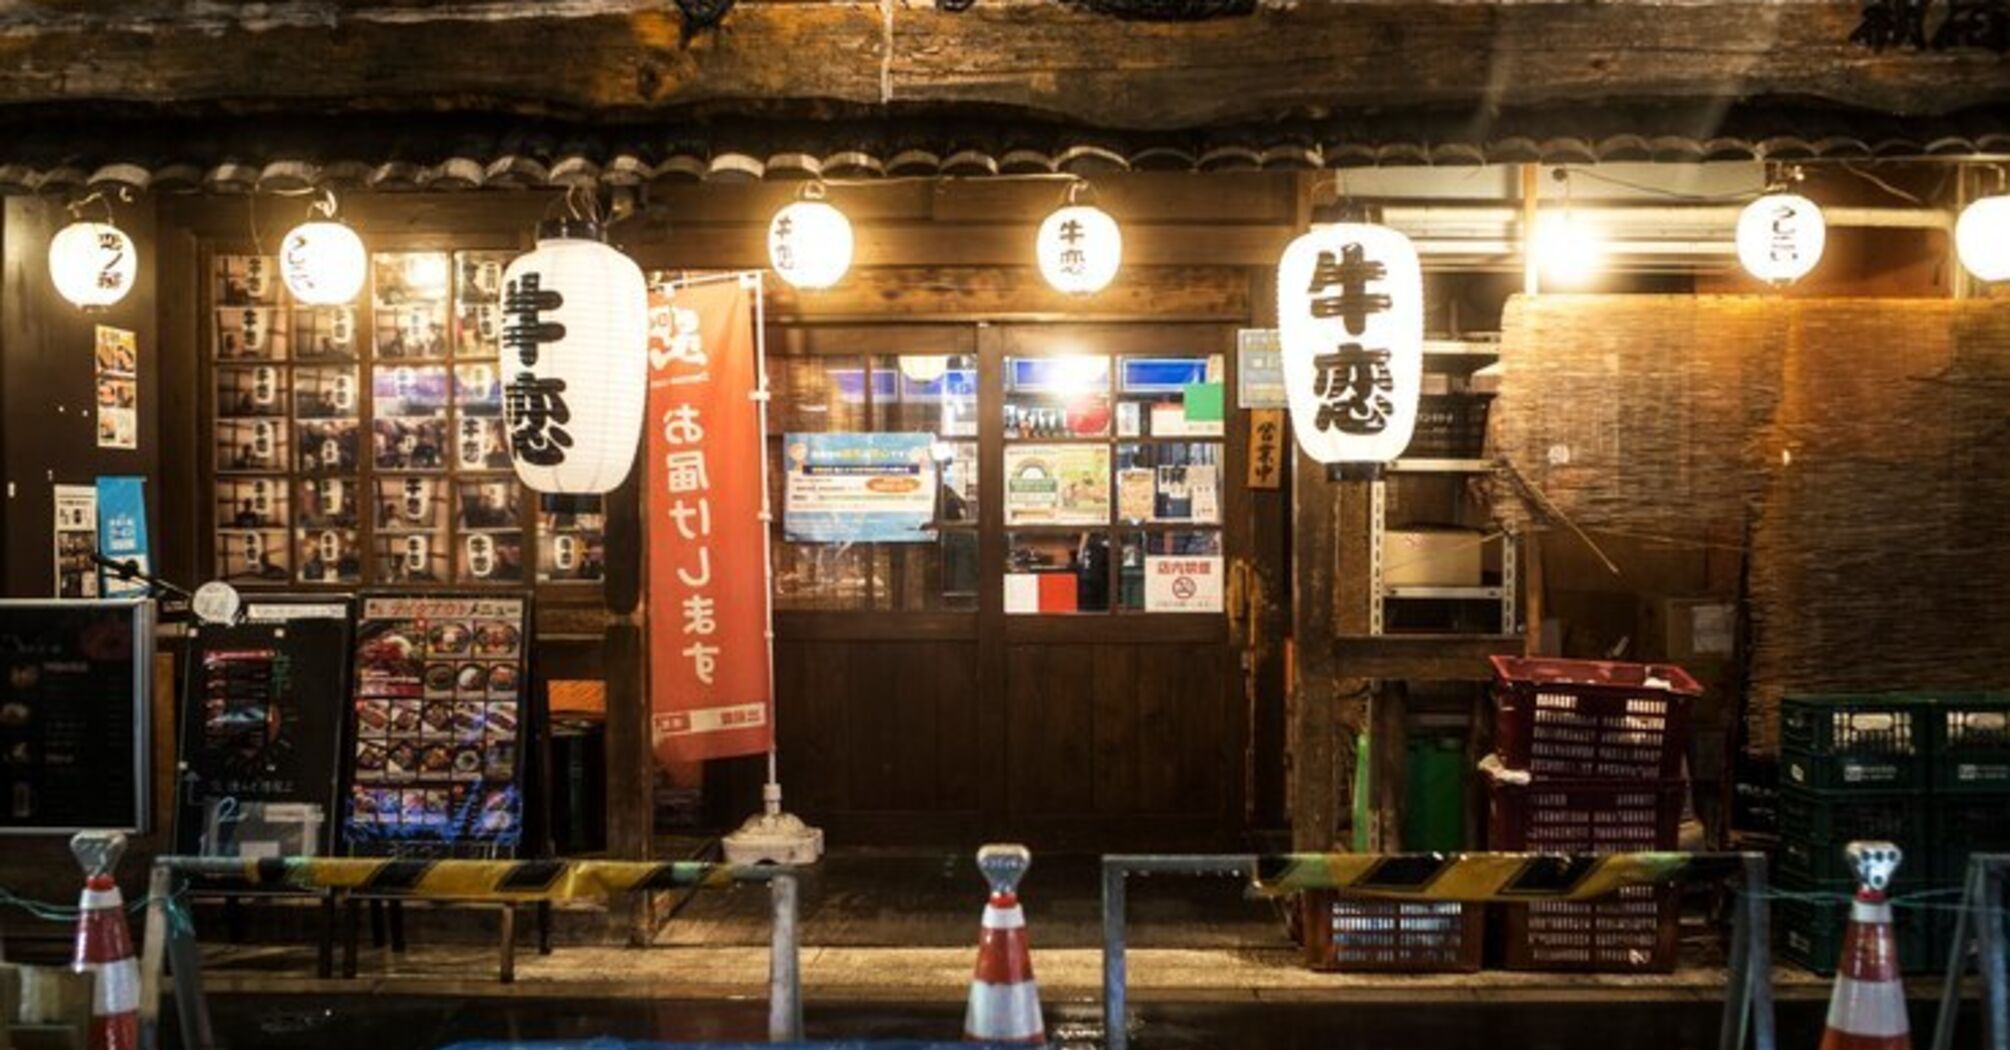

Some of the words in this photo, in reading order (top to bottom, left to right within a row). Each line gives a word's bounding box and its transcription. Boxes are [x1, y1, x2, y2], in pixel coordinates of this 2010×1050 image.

[774, 214, 795, 271] 牛恋
[1059, 219, 1086, 276] 牛恋
[502, 271, 575, 467] 牛恋
[1307, 242, 1394, 435] 牛恋
